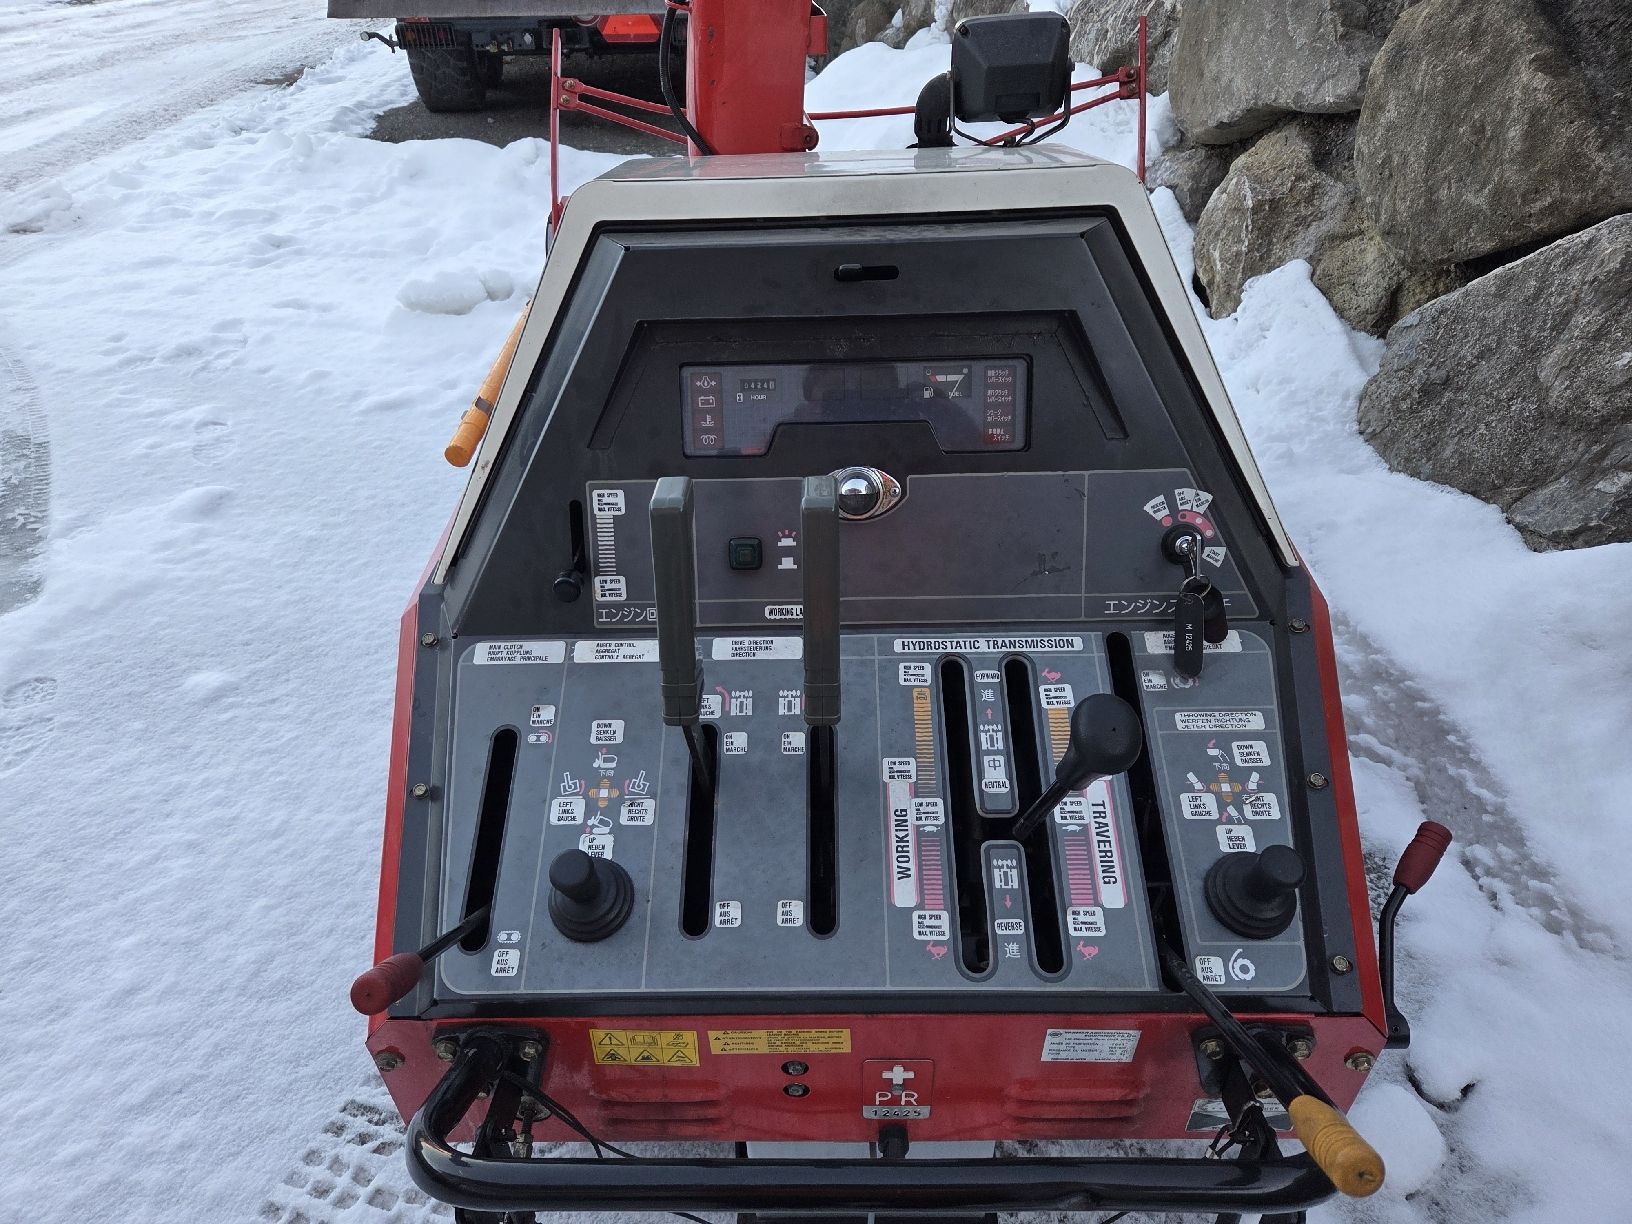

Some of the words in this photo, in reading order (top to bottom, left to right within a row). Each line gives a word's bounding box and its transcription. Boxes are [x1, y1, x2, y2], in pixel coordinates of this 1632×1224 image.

[768, 607, 794, 617] WORKING
[901, 639, 981, 651] HYDROSTATIC
[984, 638, 1075, 650] TRANSMISSION
[1185, 633, 1193, 651] 12425
[975, 672, 1000, 681] FORWARD
[980, 688, 996, 702] 進
[987, 757, 1002, 772] 中
[984, 780, 1009, 790] NEUTRAL
[1250, 802, 1273, 810] RECHTS
[626, 815, 646, 823] DROITE
[1224, 827, 1234, 835] UP
[1091, 799, 1118, 885] TRAVERING
[1226, 835, 1246, 843] HEBEN
[893, 807, 912, 881] WORKING
[1227, 842, 1248, 850] LEVER
[719, 902, 731, 910] OFF
[781, 901, 793, 909] OFF
[781, 909, 793, 917] AUS
[996, 921, 1023, 932] REVERSE
[497, 950, 510, 958] OFF
[1004, 942, 1021, 959] 進
[496, 958, 509, 966] AUS
[1199, 957, 1212, 966] OFF
[1228, 948, 1256, 981] 6
[1200, 966, 1214, 974] AUS
[871, 1108, 922, 1118] 12425
